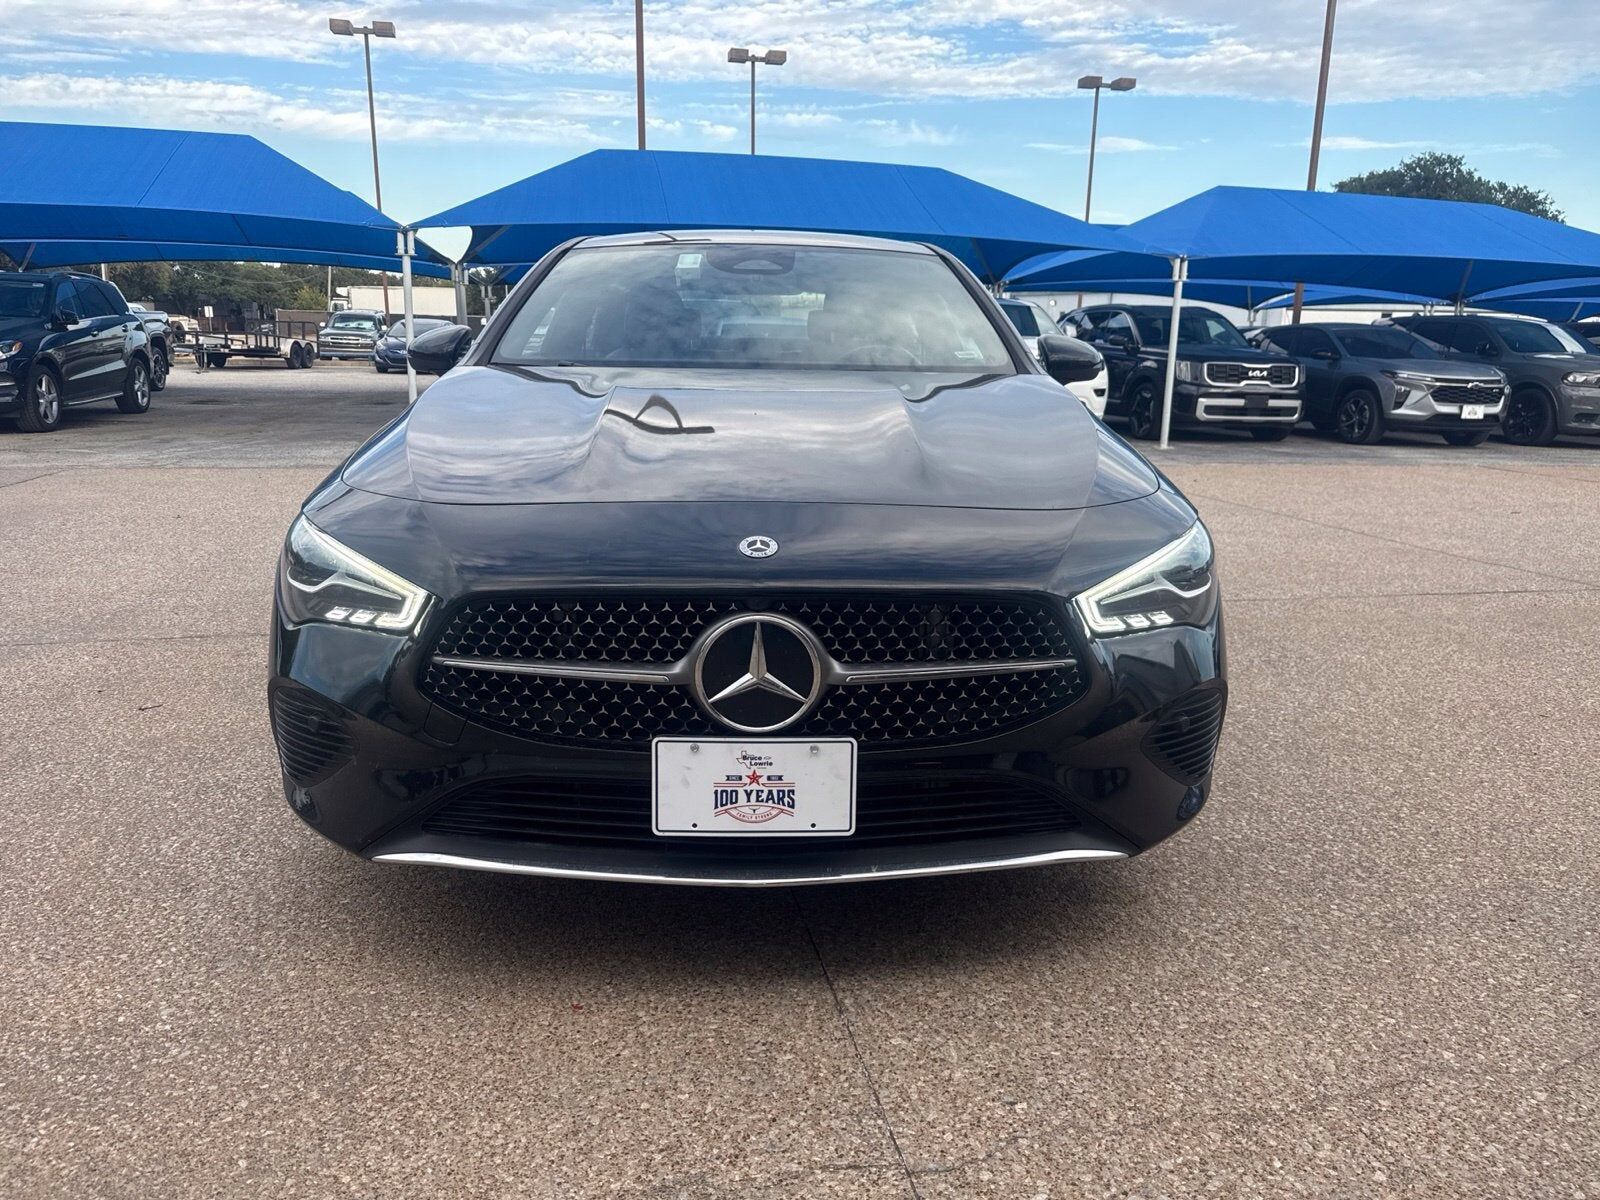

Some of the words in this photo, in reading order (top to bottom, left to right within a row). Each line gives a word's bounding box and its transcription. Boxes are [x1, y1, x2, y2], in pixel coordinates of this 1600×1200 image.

[713, 789, 739, 810] 100
[743, 789, 796, 810] YEARS
[736, 812, 753, 820] FAMILY
[754, 812, 773, 820] STRONG
